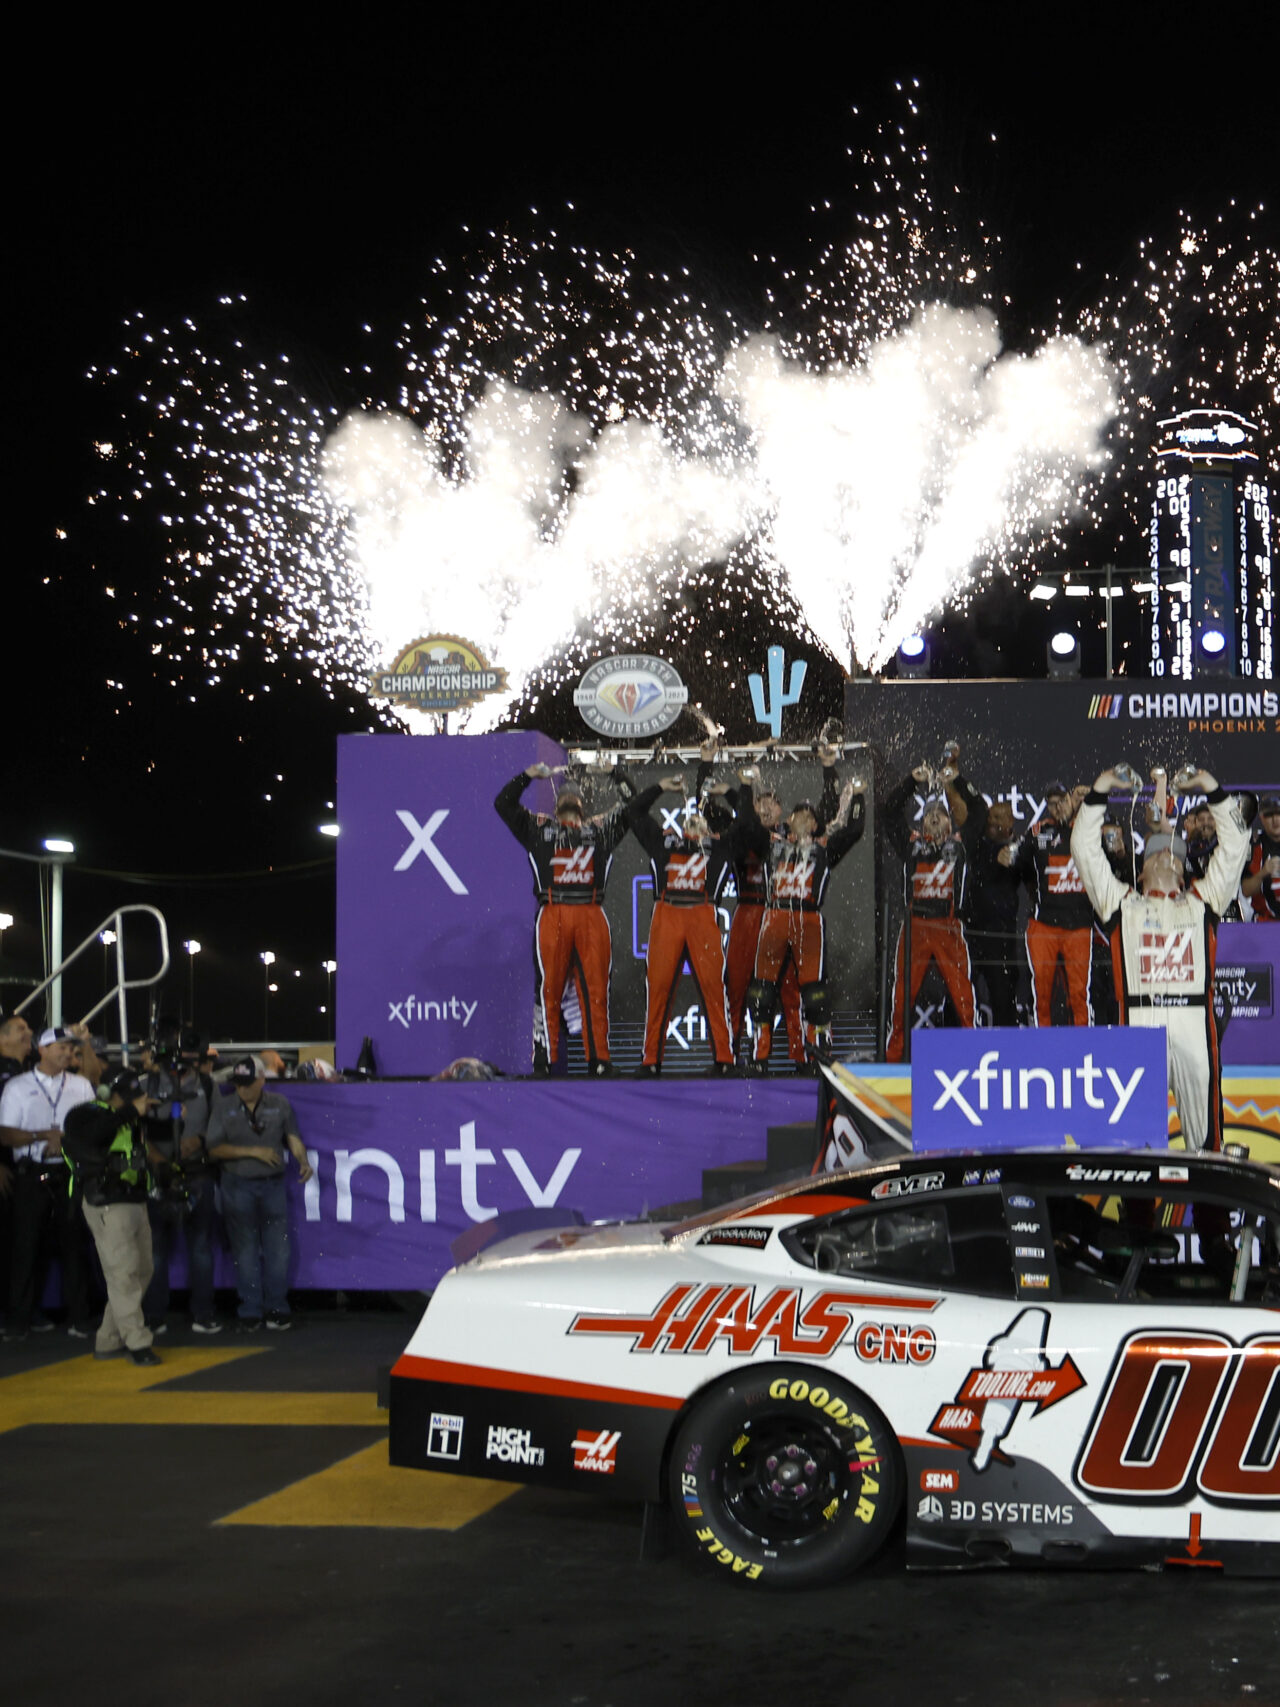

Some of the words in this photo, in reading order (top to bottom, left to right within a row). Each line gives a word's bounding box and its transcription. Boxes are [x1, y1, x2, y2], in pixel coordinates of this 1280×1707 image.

[1150, 500, 1159, 518] 1
[1240, 499, 1246, 518] 1
[1149, 518, 1159, 536] 2
[1240, 517, 1247, 534] 2
[1150, 535, 1159, 553] 3
[1240, 534, 1247, 551] 3
[1150, 553, 1159, 570] 4
[1240, 551, 1247, 569] 4
[1240, 568, 1248, 587] 5
[1240, 587, 1248, 604] 6
[1150, 605, 1160, 624] 7
[1241, 605, 1248, 623] 7
[1151, 623, 1160, 642] 8
[1241, 622, 1249, 640] 8
[1151, 641, 1160, 660] 9
[1241, 640, 1249, 658] 9
[427, 664, 461, 675] NASCAR
[588, 659, 637, 684] NASCAR
[1148, 657, 1165, 677] 10
[1239, 658, 1252, 677] 10
[381, 673, 497, 693] CHAMPIONSHIP
[409, 689, 470, 700] WEEKEND
[586, 704, 674, 735] ANNIVERSARY
[1187, 719, 1267, 733] PHOENIX
[1215, 967, 1246, 978] NASCAR
[387, 994, 479, 1030] xfinity
[932, 1050, 1146, 1126] xfinity
[566, 1281, 948, 1358] HAAS
[854, 1321, 938, 1367] CNC
[432, 1415, 462, 1429] Mobil
[938, 1408, 975, 1430] HAAS
[438, 1429, 450, 1454] 1
[487, 1424, 531, 1447] HIGH
[486, 1441, 538, 1466] POINT
[769, 1377, 881, 1524] GOODYEAR
[573, 1455, 616, 1473] HAAS
[681, 1472, 698, 1497] 75
[925, 1473, 954, 1489] SEM
[950, 1501, 977, 1521] 3D
[981, 1502, 1074, 1525] SYSTEMS
[695, 1525, 764, 1580] EAGLE
